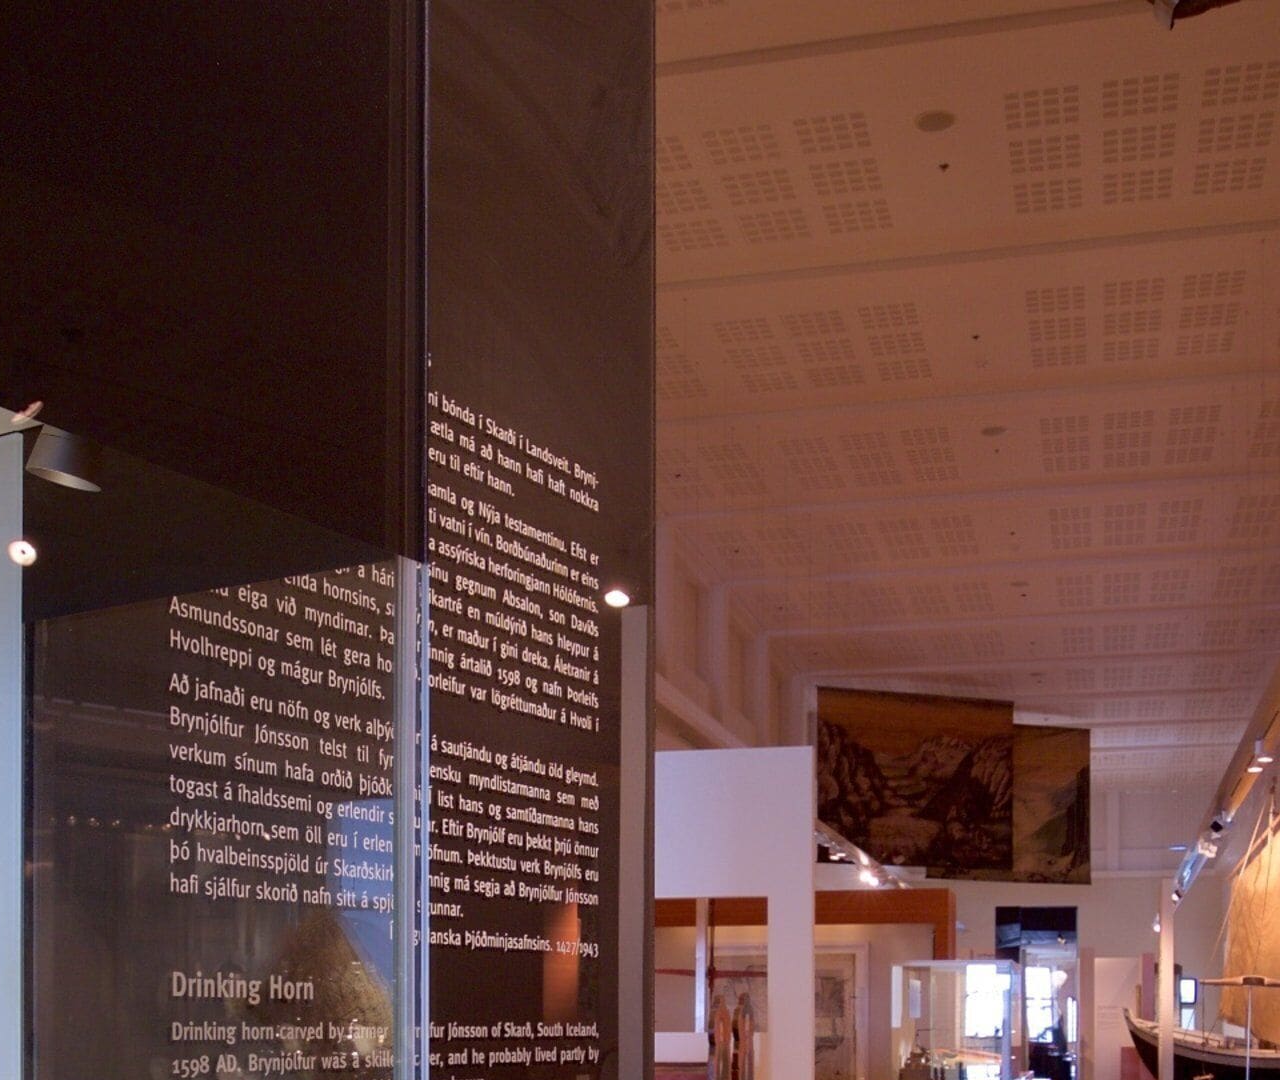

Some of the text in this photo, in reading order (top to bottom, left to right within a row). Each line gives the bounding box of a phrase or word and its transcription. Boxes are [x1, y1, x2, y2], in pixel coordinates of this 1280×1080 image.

[238, 584, 372, 639] eiga við myndirnar.
[170, 628, 385, 700] Hvolhreppi og mágur Brynjólfs.
[286, 631, 314, 652] sem
[320, 636, 337, 659] lét
[343, 647, 371, 667] gera
[169, 672, 190, 695] Að
[195, 677, 245, 707] jafnaði
[250, 695, 273, 713] eru
[278, 699, 309, 721] nöfn
[313, 709, 330, 730] og
[334, 713, 362, 733] verk
[170, 705, 369, 763] Brynjólfur Jónsson telst til
[169, 774, 385, 823] togast á íhaldssemi og erlendir
[271, 824, 299, 841] sem
[305, 825, 322, 845] öll
[327, 831, 348, 848] eru
[353, 831, 358, 849] í
[170, 838, 329, 875] þó hvalbeinsspjöld úr
[170, 872, 369, 909] hafi sjálfur skorið nafn sitt á
[172, 970, 314, 1005] Drinking Horn
[171, 1021, 237, 1045] Drinking
[241, 1021, 274, 1041] horn
[279, 1018, 324, 1042] carved
[328, 1021, 345, 1044] by
[172, 1055, 210, 1078] 1598
[248, 1049, 316, 1077] Brynjólfur
[321, 1051, 347, 1070] was
[351, 1048, 360, 1069] a
